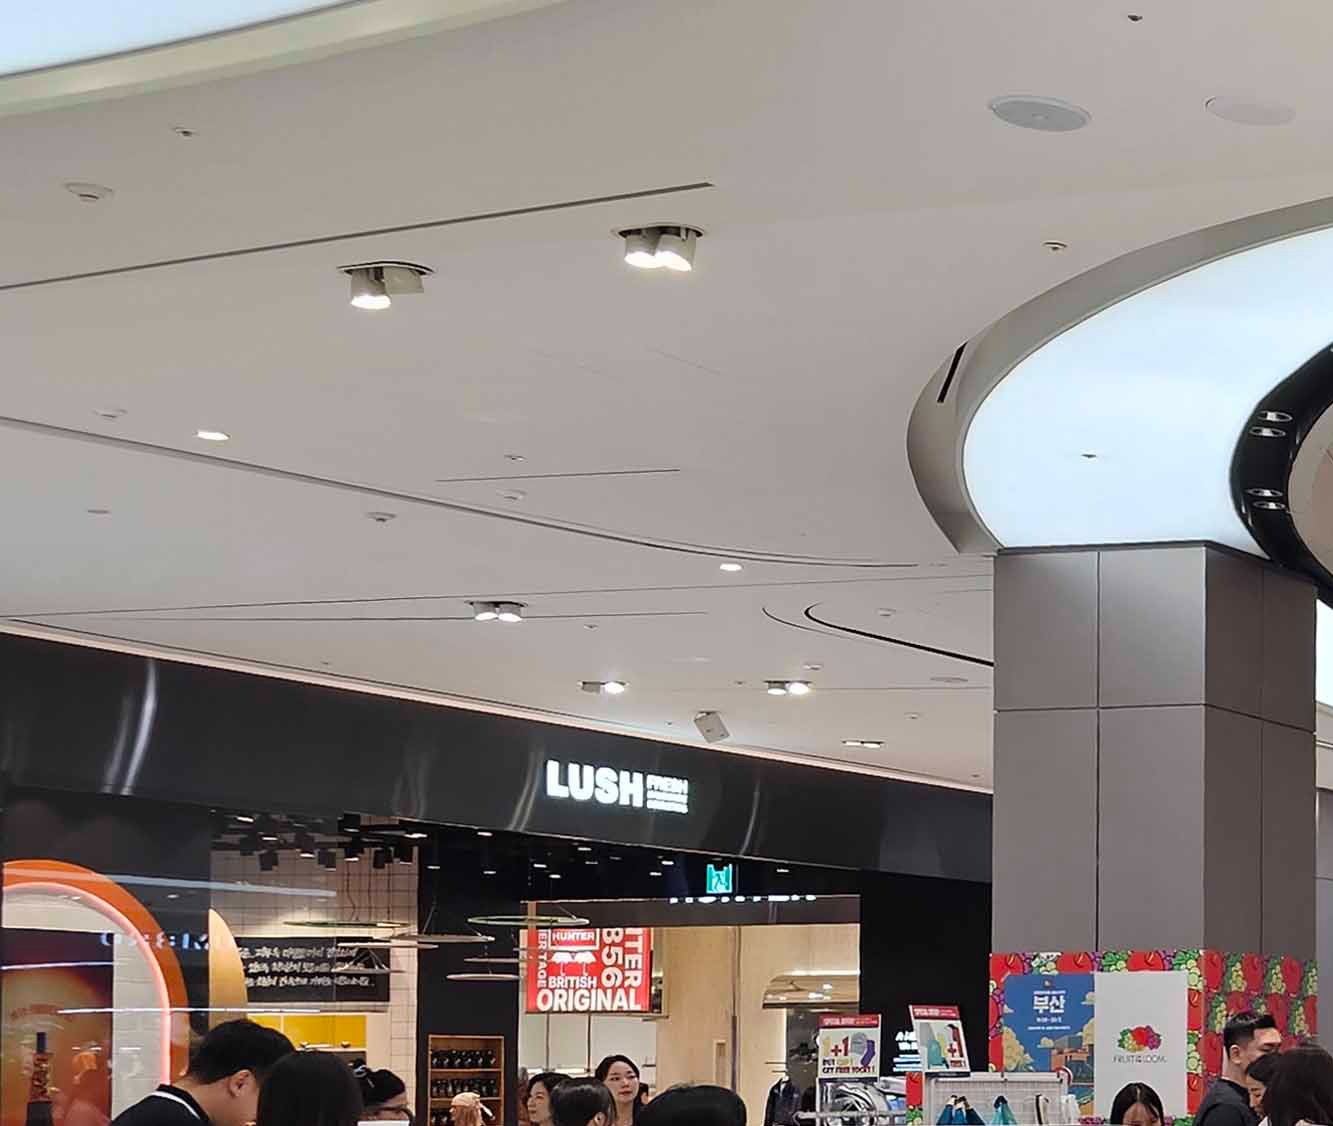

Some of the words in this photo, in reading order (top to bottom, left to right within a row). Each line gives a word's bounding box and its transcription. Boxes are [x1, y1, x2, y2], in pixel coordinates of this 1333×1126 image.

[546, 759, 644, 808] LUSH
[552, 931, 595, 941] HUNTER
[548, 976, 597, 988] BRITISH
[537, 988, 641, 1011] ORIGINAL
[1033, 995, 1066, 1014] 부산
[1113, 1055, 1135, 1064] FRUIT
